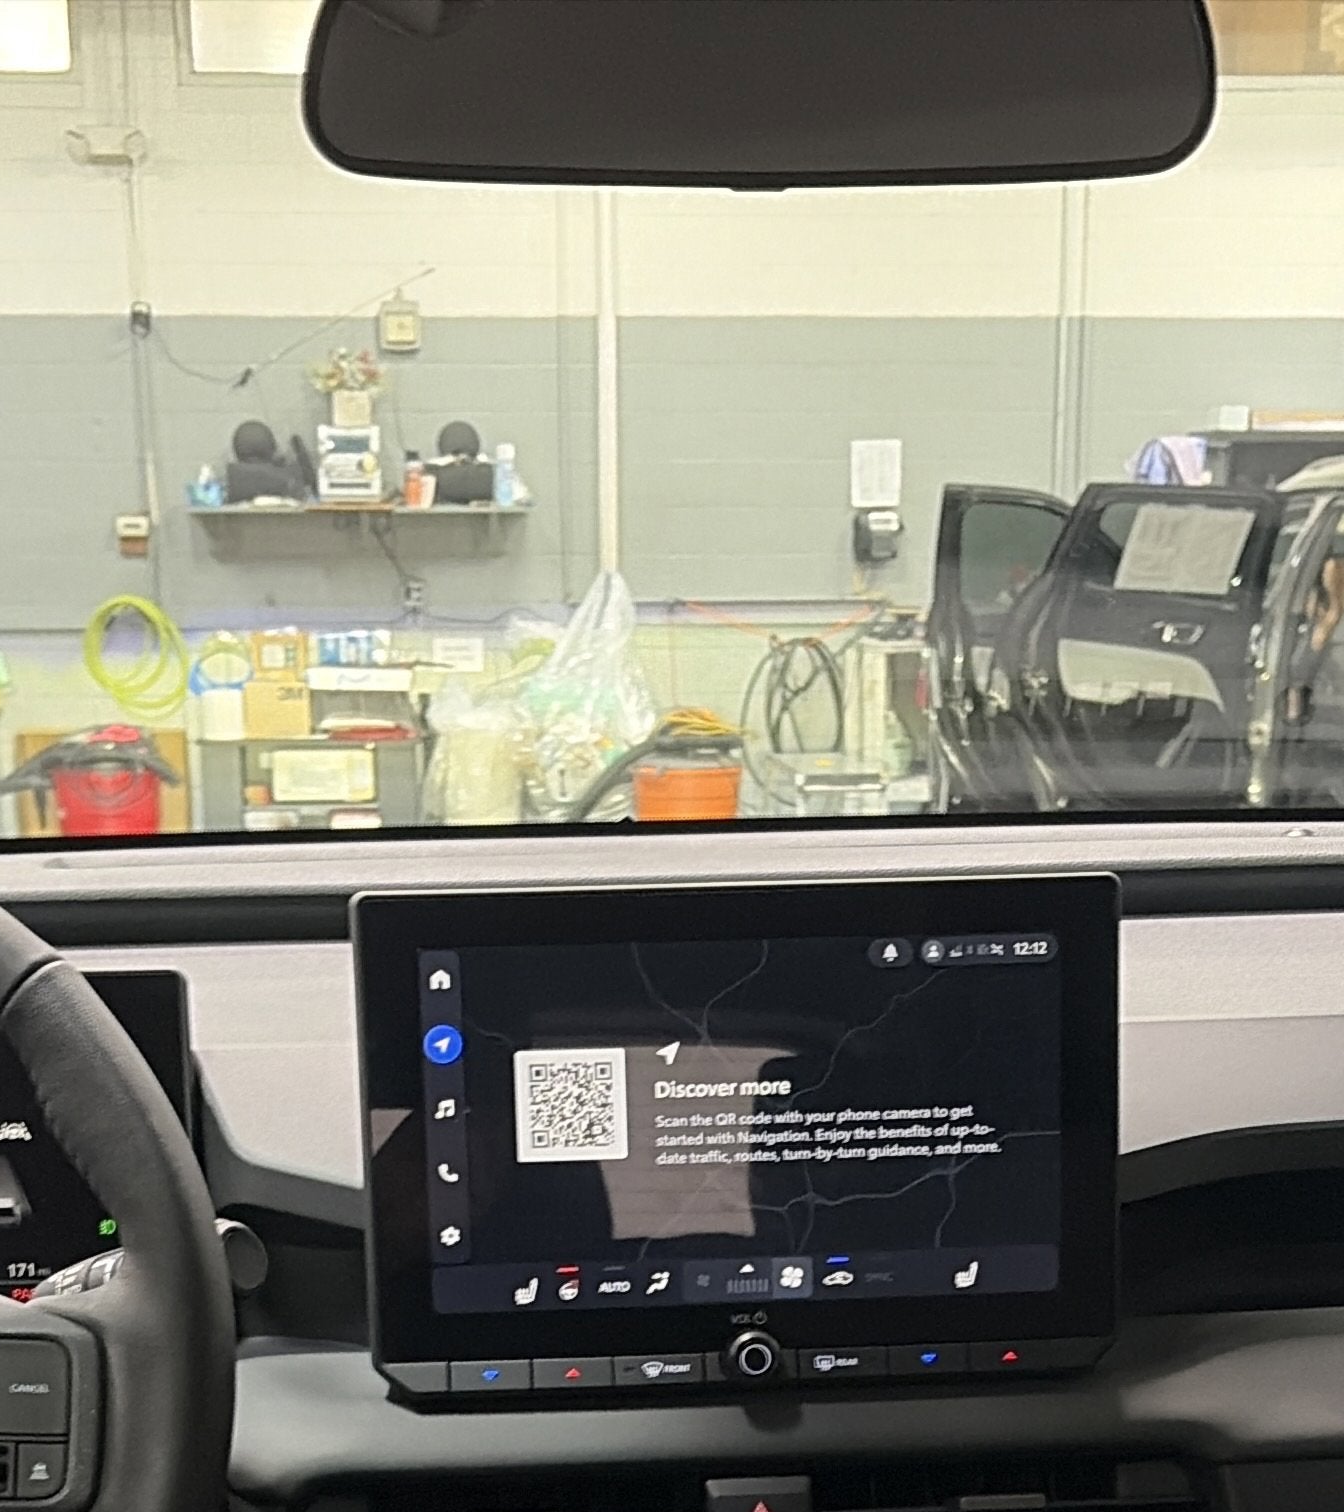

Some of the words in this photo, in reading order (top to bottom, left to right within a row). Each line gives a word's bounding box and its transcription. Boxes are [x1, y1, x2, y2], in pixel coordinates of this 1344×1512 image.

[1012, 941, 1048, 956] 12:12
[654, 1080, 737, 1098] Discover
[739, 1080, 792, 1096] more
[655, 1115, 688, 1128] Scan
[689, 1113, 713, 1127] the
[714, 1112, 737, 1126] QR
[736, 1111, 773, 1125] code
[773, 1110, 804, 1124] with
[804, 1111, 837, 1126] your
[836, 1108, 881, 1124] phone
[881, 1109, 931, 1120] camera
[932, 1106, 948, 1119] to
[949, 1105, 974, 1120] get
[655, 1132, 704, 1146] started
[705, 1131, 736, 1144] with
[736, 1130, 813, 1146] Navigation.
[814, 1128, 852, 1144] Enjoy
[853, 1127, 877, 1140] the
[877, 1124, 932, 1139] benefits
[933, 1123, 950, 1137] of
[950, 1123, 996, 1138] up-to-
[655, 1152, 688, 1165] date
[689, 1150, 732, 1164] traffic,
[734, 1149, 781, 1163] routes,
[782, 1146, 866, 1162] turn-by-turn
[867, 1143, 933, 1160] guidance,
[934, 1141, 962, 1155] and
[962, 1142, 1002, 1155] more.
[7, 1263, 36, 1278] 171
[597, 1280, 632, 1294] AUTO
